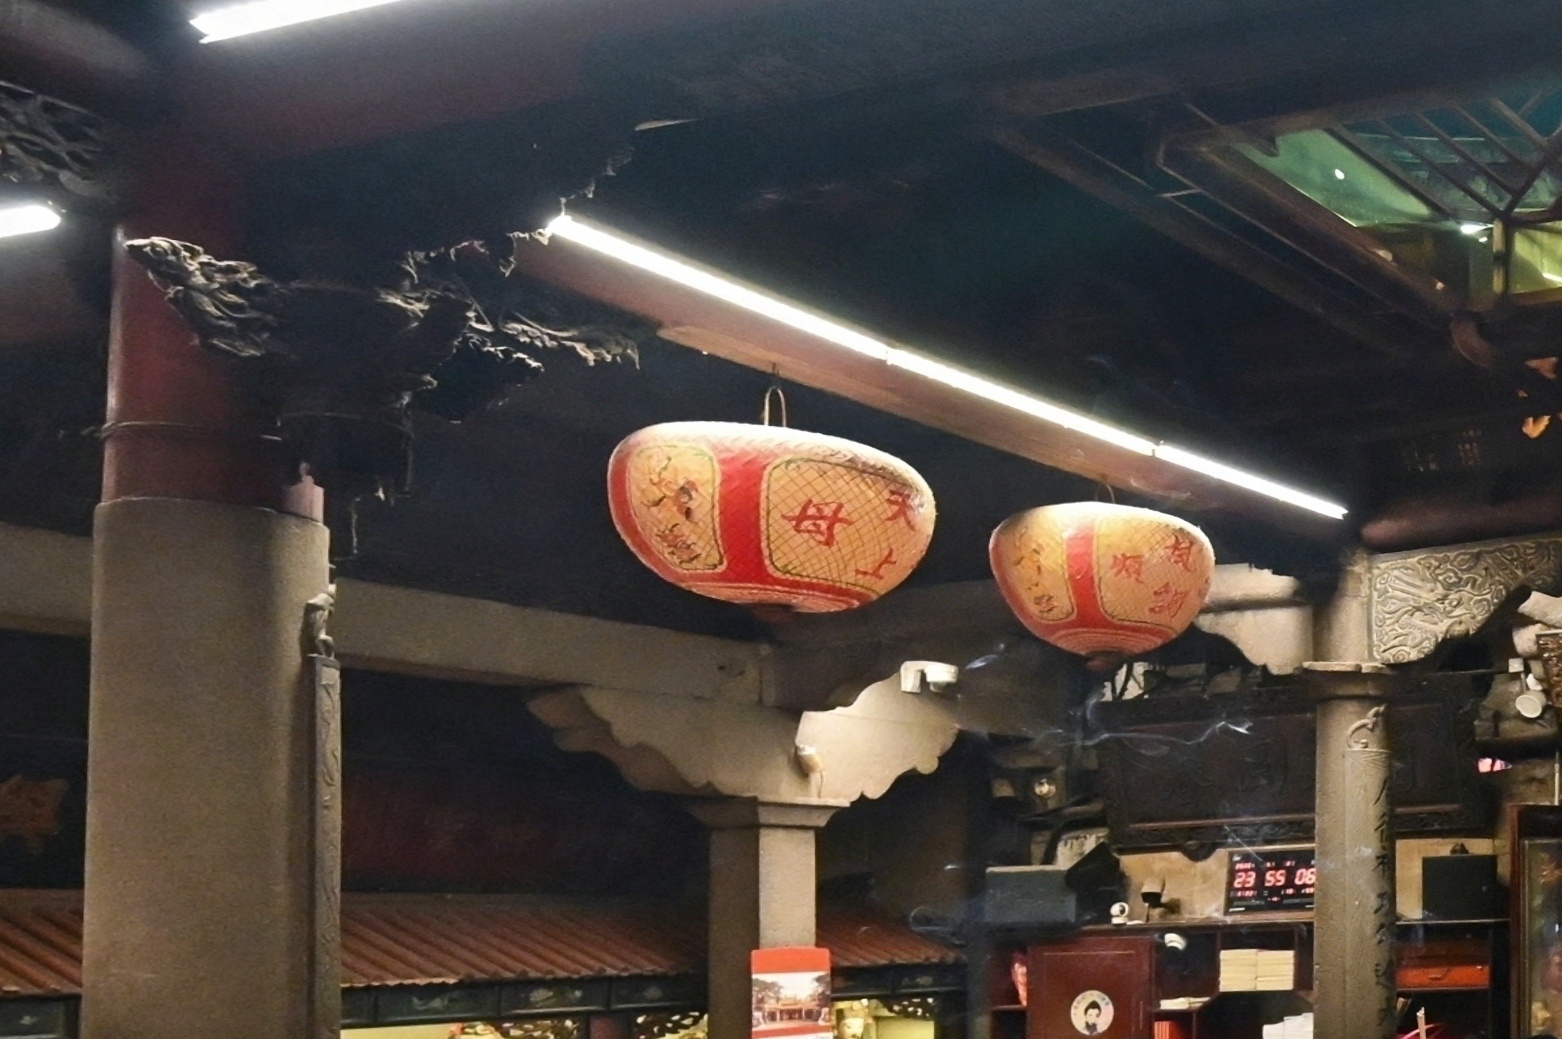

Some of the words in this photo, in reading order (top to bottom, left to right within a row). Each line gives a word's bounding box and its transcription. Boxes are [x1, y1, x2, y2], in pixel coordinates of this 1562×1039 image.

[781, 499, 854, 548] 母
[1233, 871, 1256, 888] 23
[1264, 869, 1286, 887] 55
